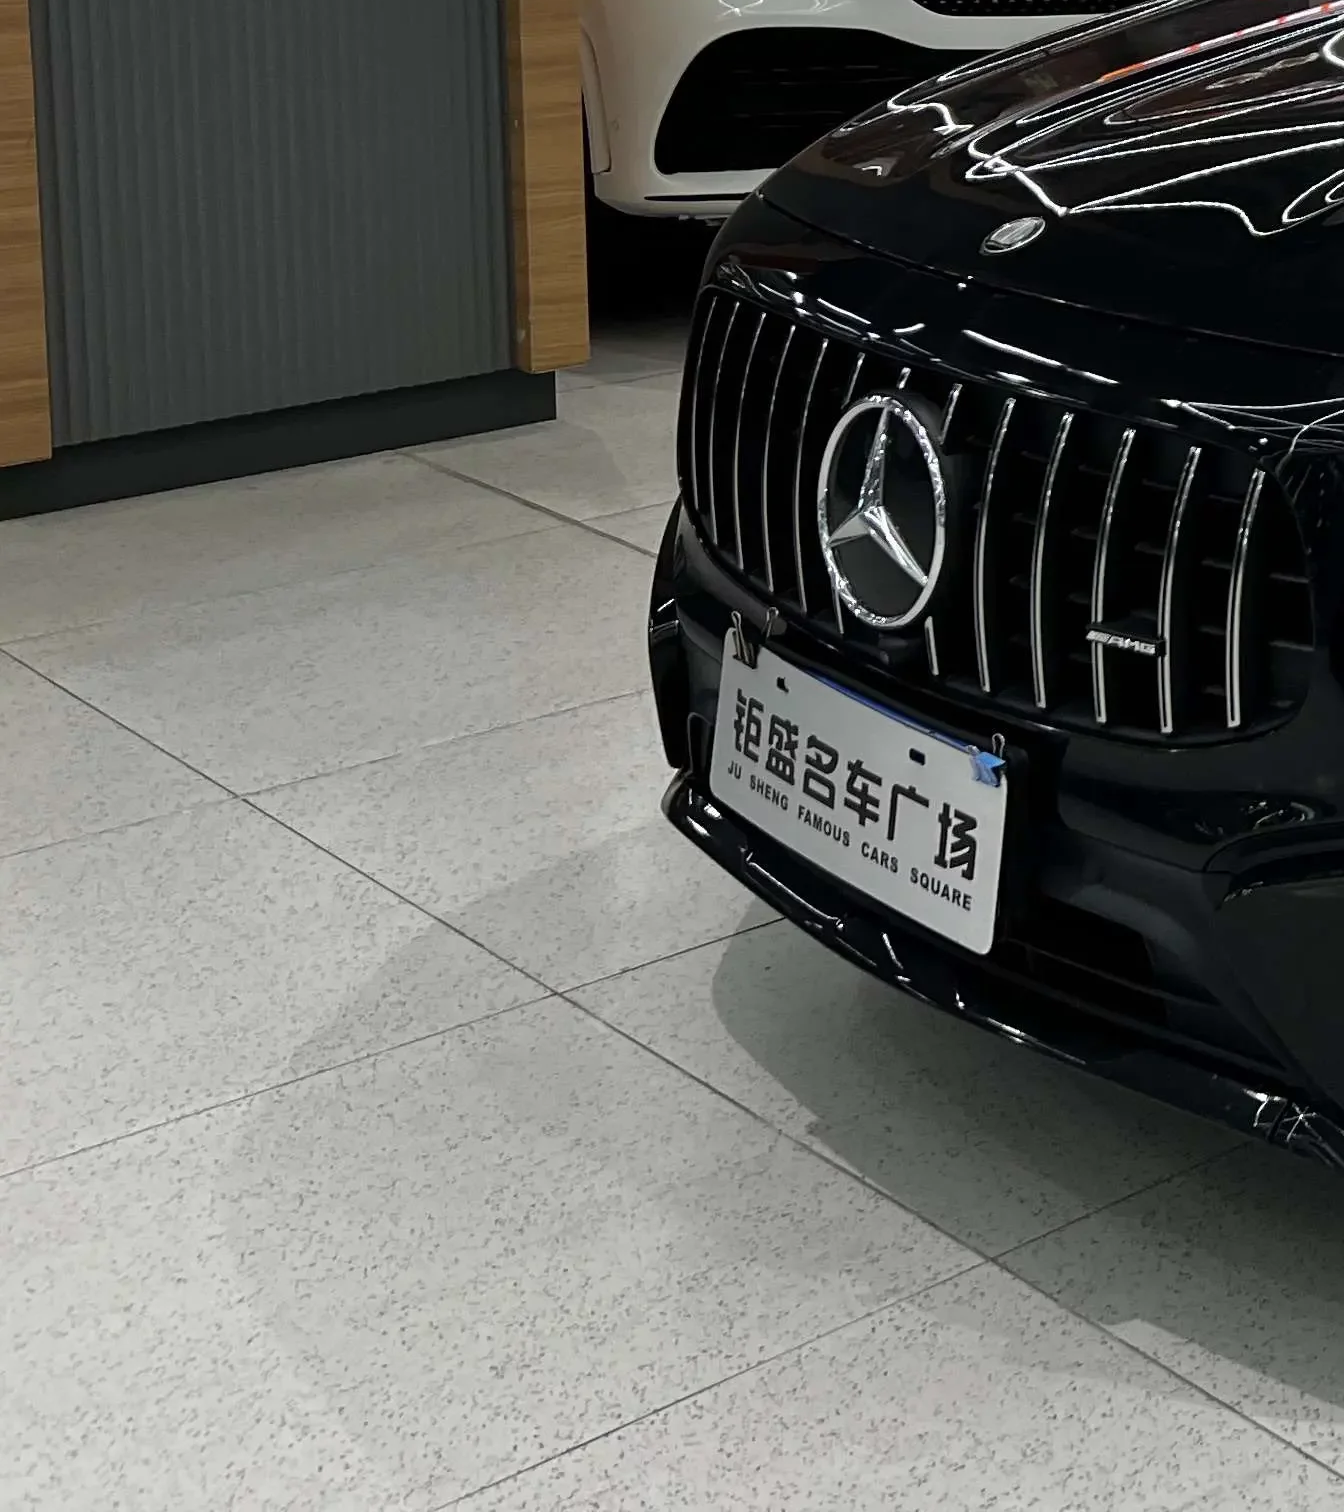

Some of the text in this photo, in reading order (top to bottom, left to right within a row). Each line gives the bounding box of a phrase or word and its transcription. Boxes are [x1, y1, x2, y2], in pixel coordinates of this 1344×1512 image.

[1107, 634, 1156, 656] AMG
[727, 759, 973, 911] JU SHENG FAMOUS CARS SQUARE
[732, 688, 978, 881] 钜盛名车广场
